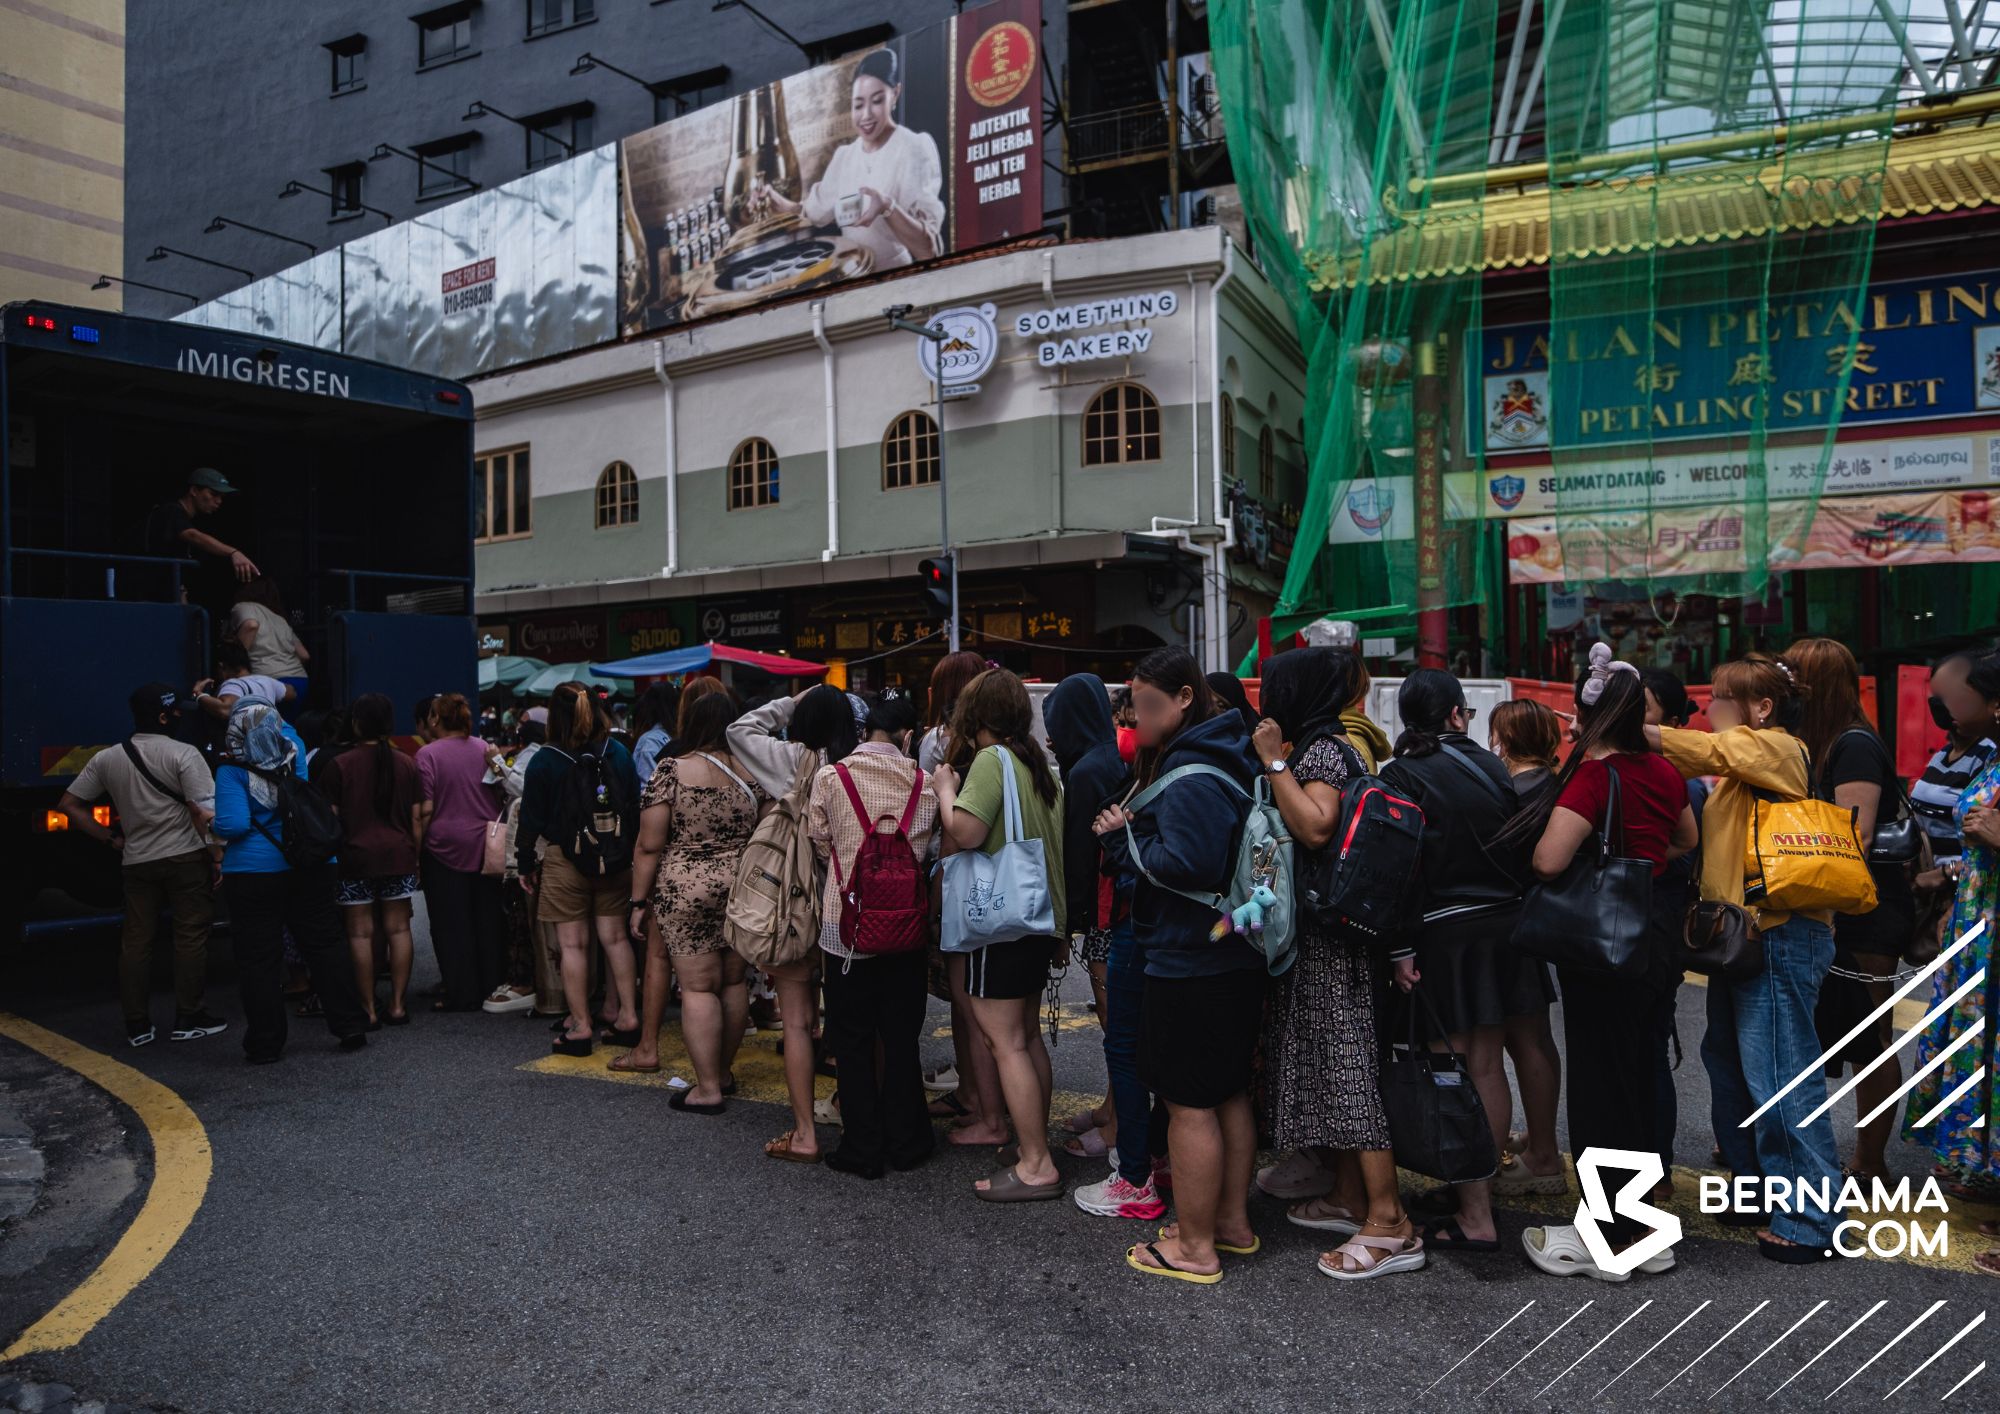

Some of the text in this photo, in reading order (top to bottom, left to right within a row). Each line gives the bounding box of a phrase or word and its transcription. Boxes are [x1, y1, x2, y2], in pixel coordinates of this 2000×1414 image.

[969, 106, 1031, 140] AUTENTIK
[966, 129, 1034, 163] JELI HERBA
[974, 153, 1025, 183] DAN TEH
[978, 178, 1021, 204] HERBA
[442, 260, 496, 292] SPACE FOR RENT
[1018, 295, 1173, 333] SOMETHING
[1491, 282, 2000, 370] JALAN PETALIN
[1042, 332, 1149, 362] BAKERY
[178, 347, 350, 399] IMIGRESEN
[1579, 377, 1945, 436] PETALING STREET
[1539, 464, 1766, 493] SELAMAT DATANG WELCOME
[730, 609, 782, 623] CURRENCY
[730, 624, 782, 637] EXCHANGE
[1027, 616, 1073, 640] 第一家
[1777, 849, 1861, 862] Always Low Prices
[1349, 920, 1378, 936] YAMAHA
